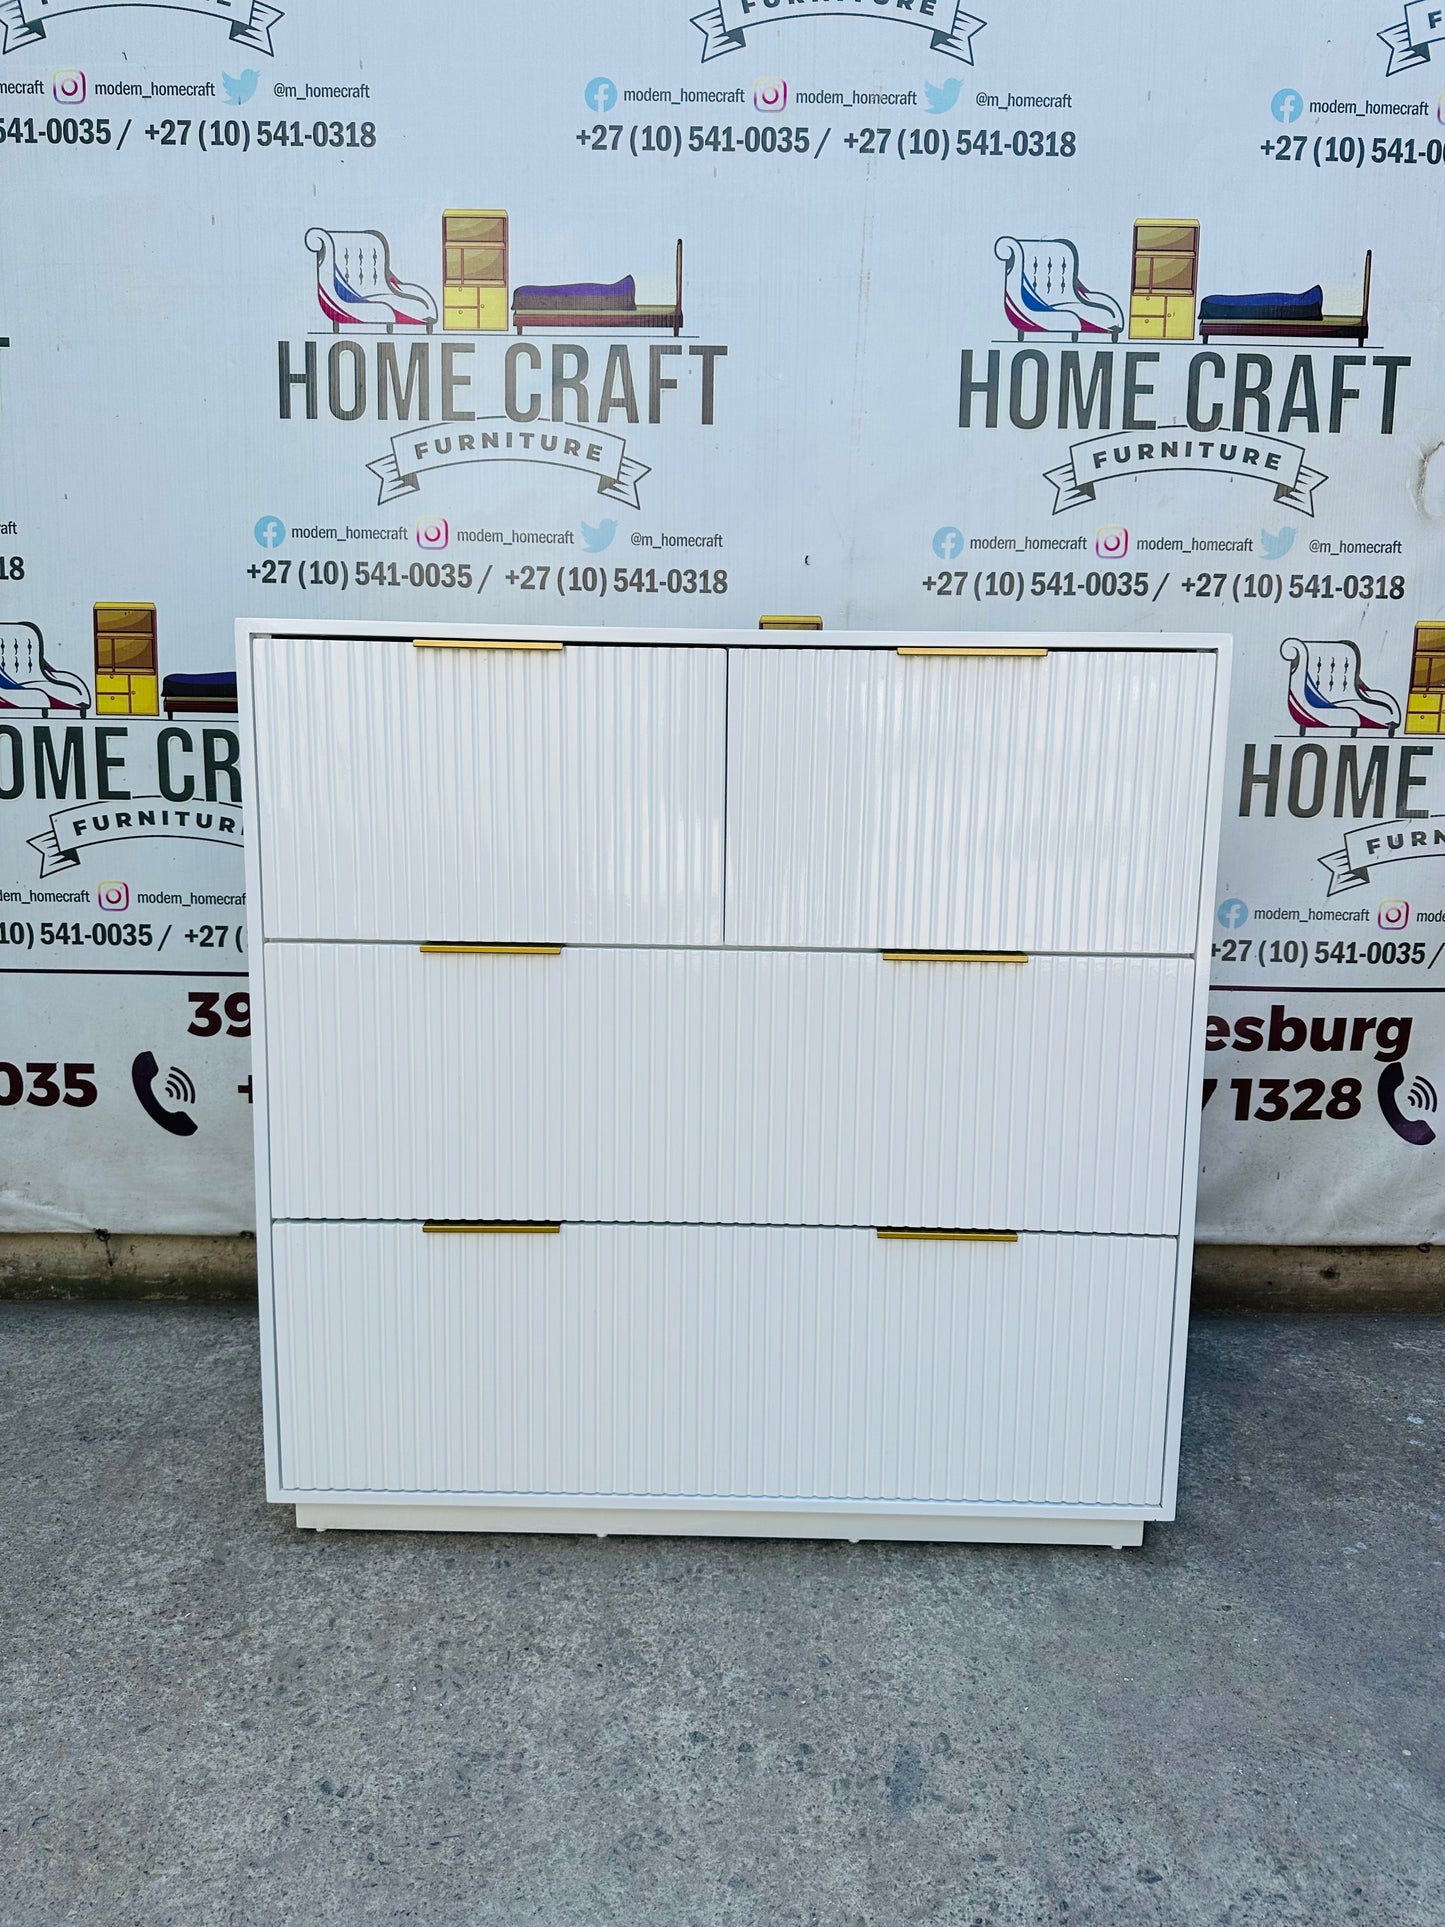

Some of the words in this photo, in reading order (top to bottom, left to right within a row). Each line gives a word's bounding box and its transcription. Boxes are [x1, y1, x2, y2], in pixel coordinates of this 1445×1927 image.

[274, 83, 370, 100] @m_homecraft
[976, 92, 1072, 110] @m_homecraft
[145, 120, 191, 145] +27
[199, 120, 250, 152] (10)
[257, 121, 376, 147] 541-0318
[576, 125, 623, 150] +27
[630, 126, 681, 157] (10)
[689, 126, 809, 153] 541-0035
[844, 128, 891, 153] +27
[898, 129, 949, 160] (10)
[956, 130, 1076, 157] 541-0318
[1261, 135, 1307, 160] +27
[1314, 137, 1364, 168] (10)
[1371, 138, 1445, 164] 541-0
[278, 341, 476, 422] HOME
[504, 343, 728, 424] CRAFT
[959, 349, 1160, 431] HOME
[1186, 351, 1411, 435] CRAFT
[414, 431, 603, 463] FURNITURE
[1093, 440, 1282, 471] FURNITURE
[631, 532, 723, 549] @m_homecraft
[1310, 540, 1402, 555] @m_homecraft
[247, 560, 291, 583] +27
[299, 561, 348, 590] (10)
[355, 562, 472, 588] 541-0035
[506, 566, 550, 590] +27
[558, 567, 607, 597] (10)
[614, 568, 727, 594] 541-0318
[923, 571, 968, 595] +27
[974, 572, 1024, 601] (10)
[1031, 572, 1148, 596] 541-0035
[1182, 573, 1227, 597] +27
[1233, 574, 1282, 603] (10)
[1289, 575, 1405, 599] 541-0318
[1239, 743, 1433, 819] HOME
[73, 810, 243, 836] FURNITUR
[41, 923, 152, 946] 541-0035
[185, 925, 228, 947] +27
[1259, 940, 1308, 968] (10)
[1315, 941, 1425, 964] 541-0035
[1230, 1078, 1362, 1121] 1328
